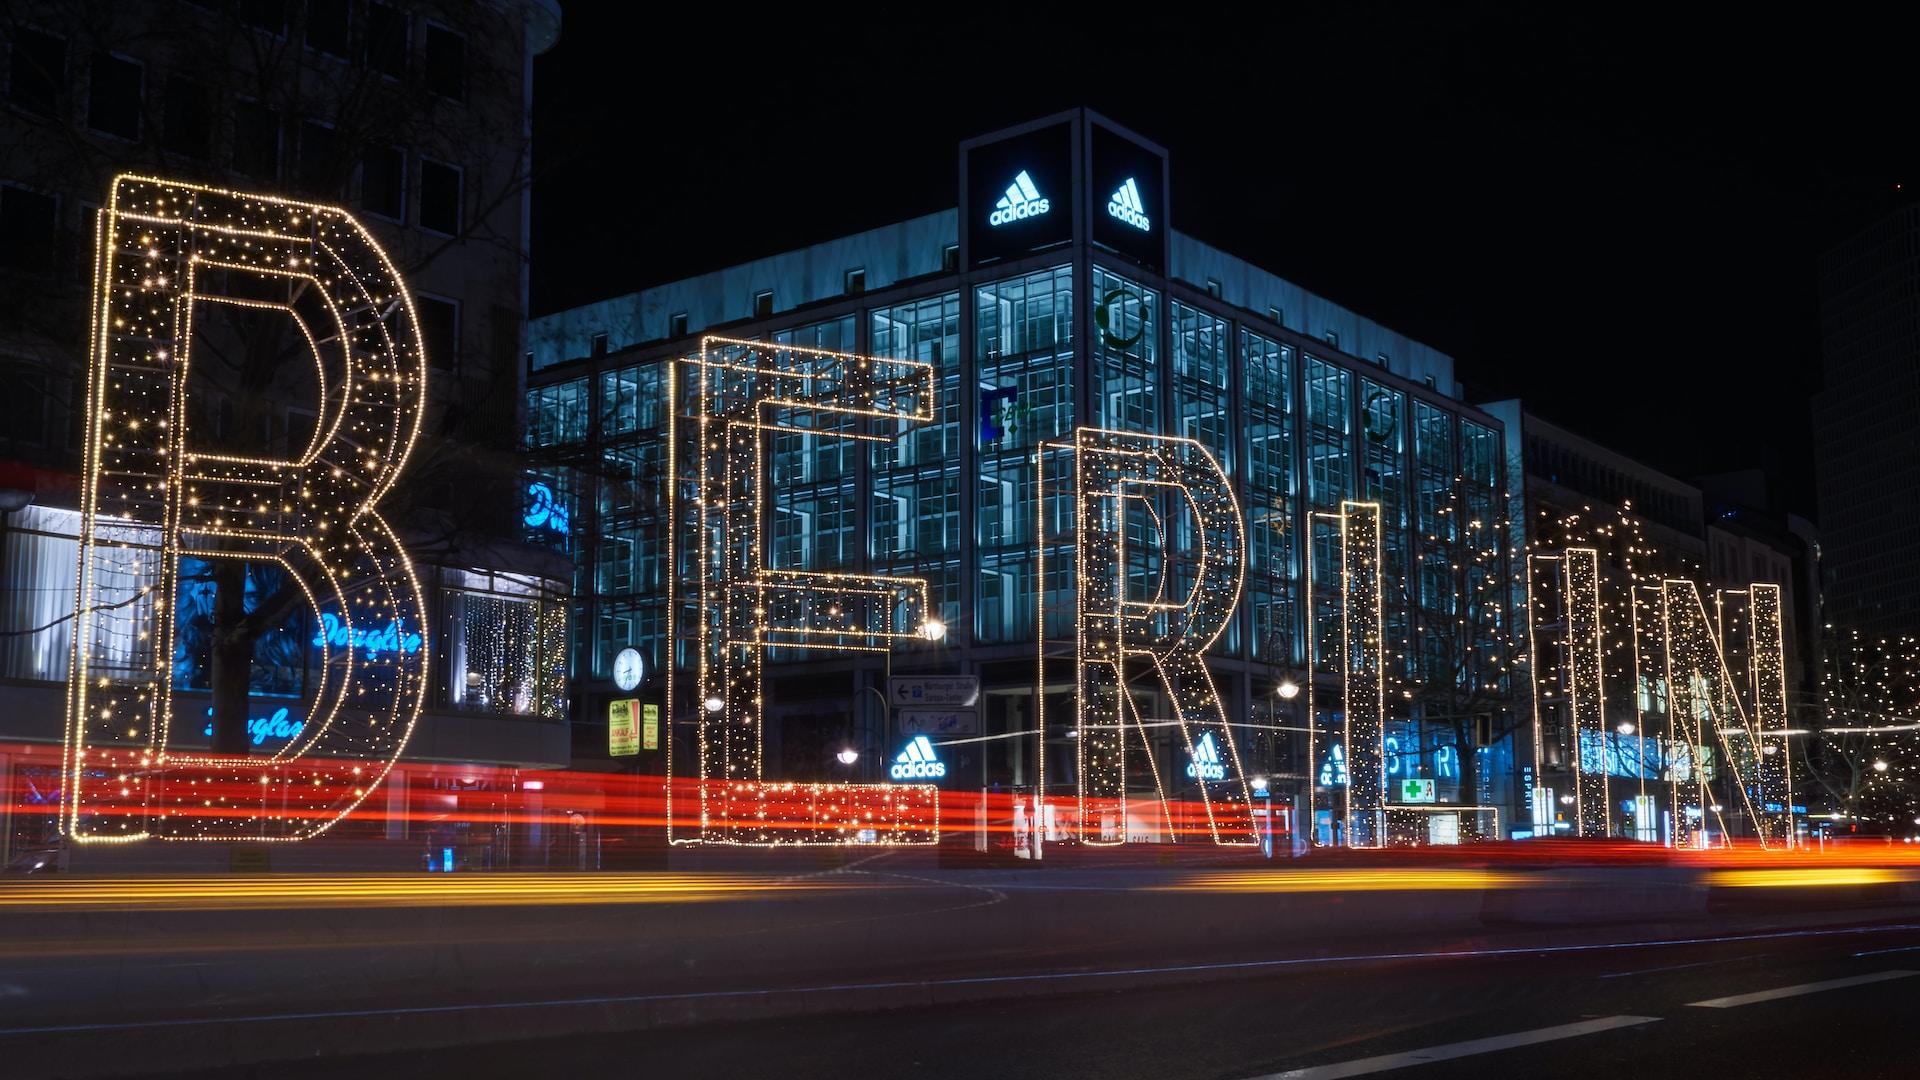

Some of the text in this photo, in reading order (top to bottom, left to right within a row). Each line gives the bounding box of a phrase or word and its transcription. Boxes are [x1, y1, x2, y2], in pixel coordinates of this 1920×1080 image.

[989, 198, 1050, 226] adidas
[1107, 200, 1150, 232] adidas
[60, 172, 1794, 849] BERLIN
[890, 760, 946, 779] adidas
[1524, 766, 1533, 811] ESPRIT
